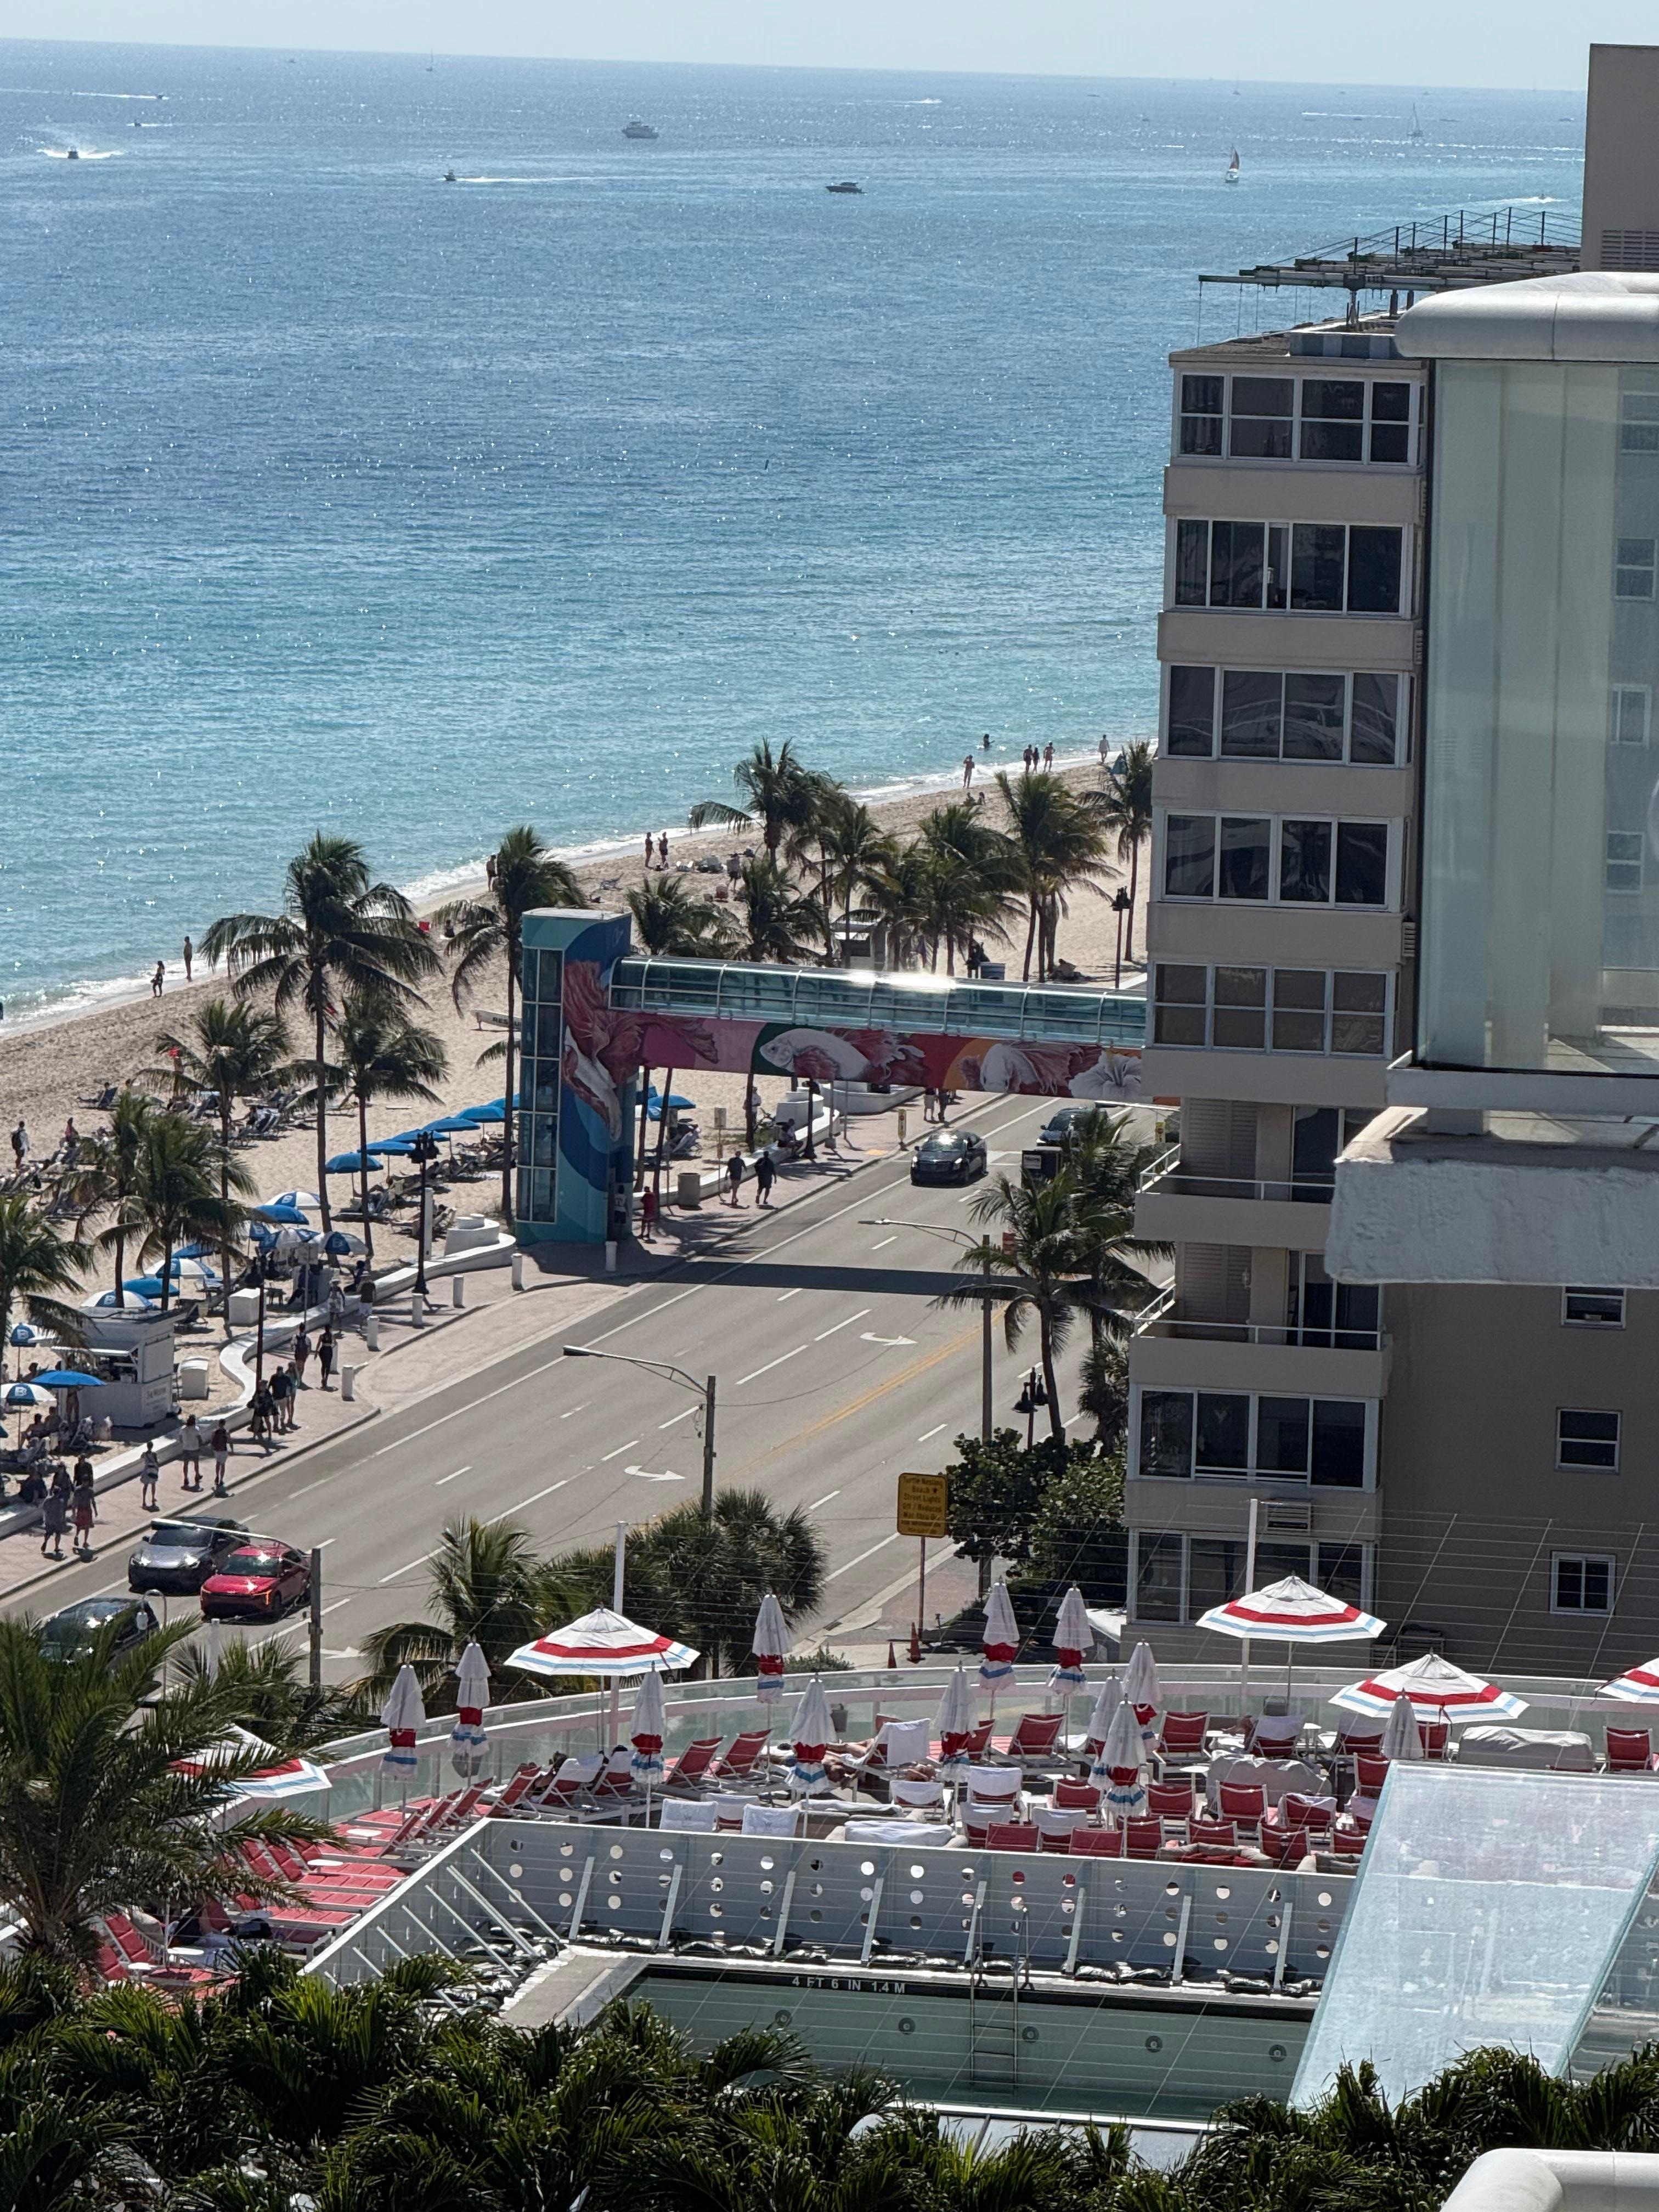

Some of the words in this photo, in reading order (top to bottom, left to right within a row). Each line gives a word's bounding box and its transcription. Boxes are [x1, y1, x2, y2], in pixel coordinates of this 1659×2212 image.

[14, 1386, 27, 1396] B
[792, 1976, 800, 1987] 4
[807, 1977, 825, 1988] FT
[831, 1978, 839, 1989] 6
[848, 1979, 861, 1991] IN
[872, 1981, 890, 1993] 1.4
[894, 1983, 905, 1994] M
